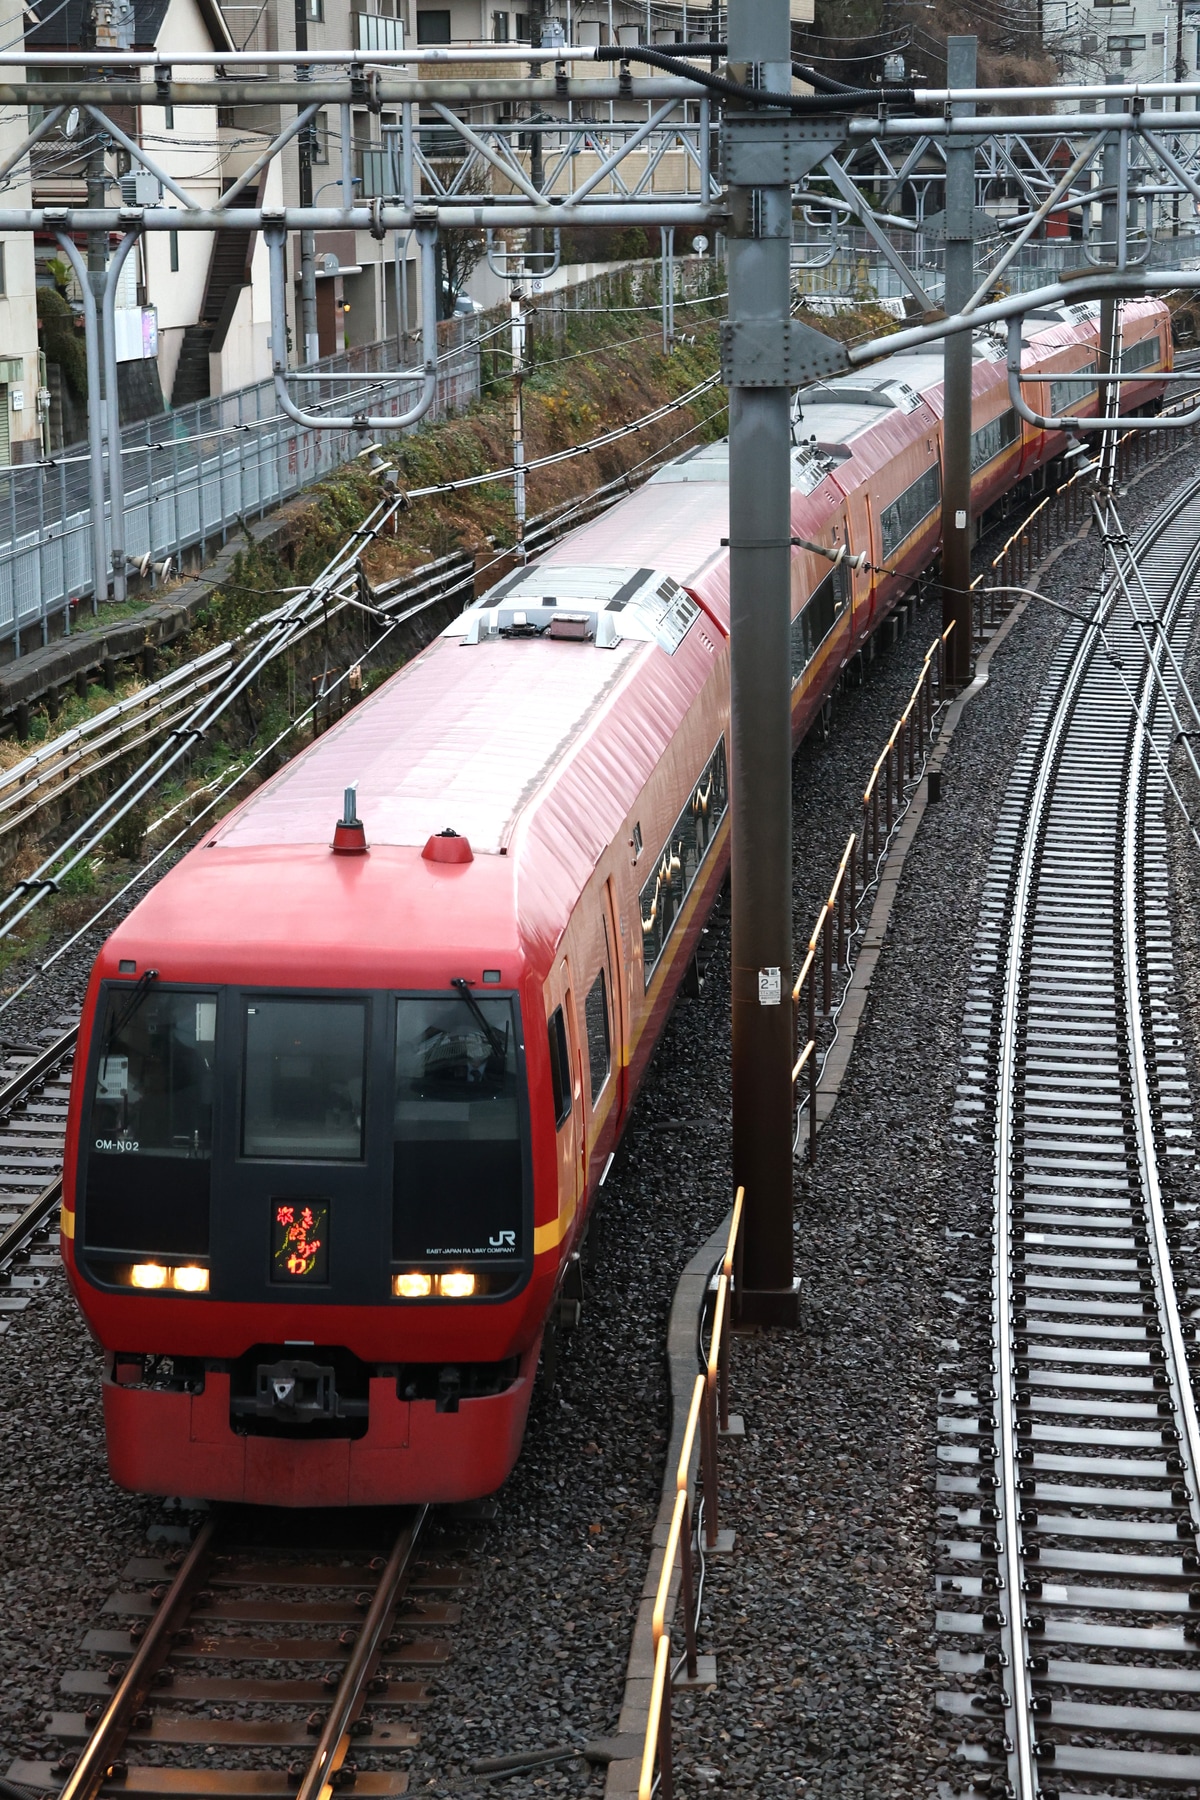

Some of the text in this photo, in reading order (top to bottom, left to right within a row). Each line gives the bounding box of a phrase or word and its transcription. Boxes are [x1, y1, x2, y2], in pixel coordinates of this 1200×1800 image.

[760, 978, 779, 990] 2-1
[95, 1139, 139, 1151] OM-N02
[489, 1230, 516, 1246] JR
